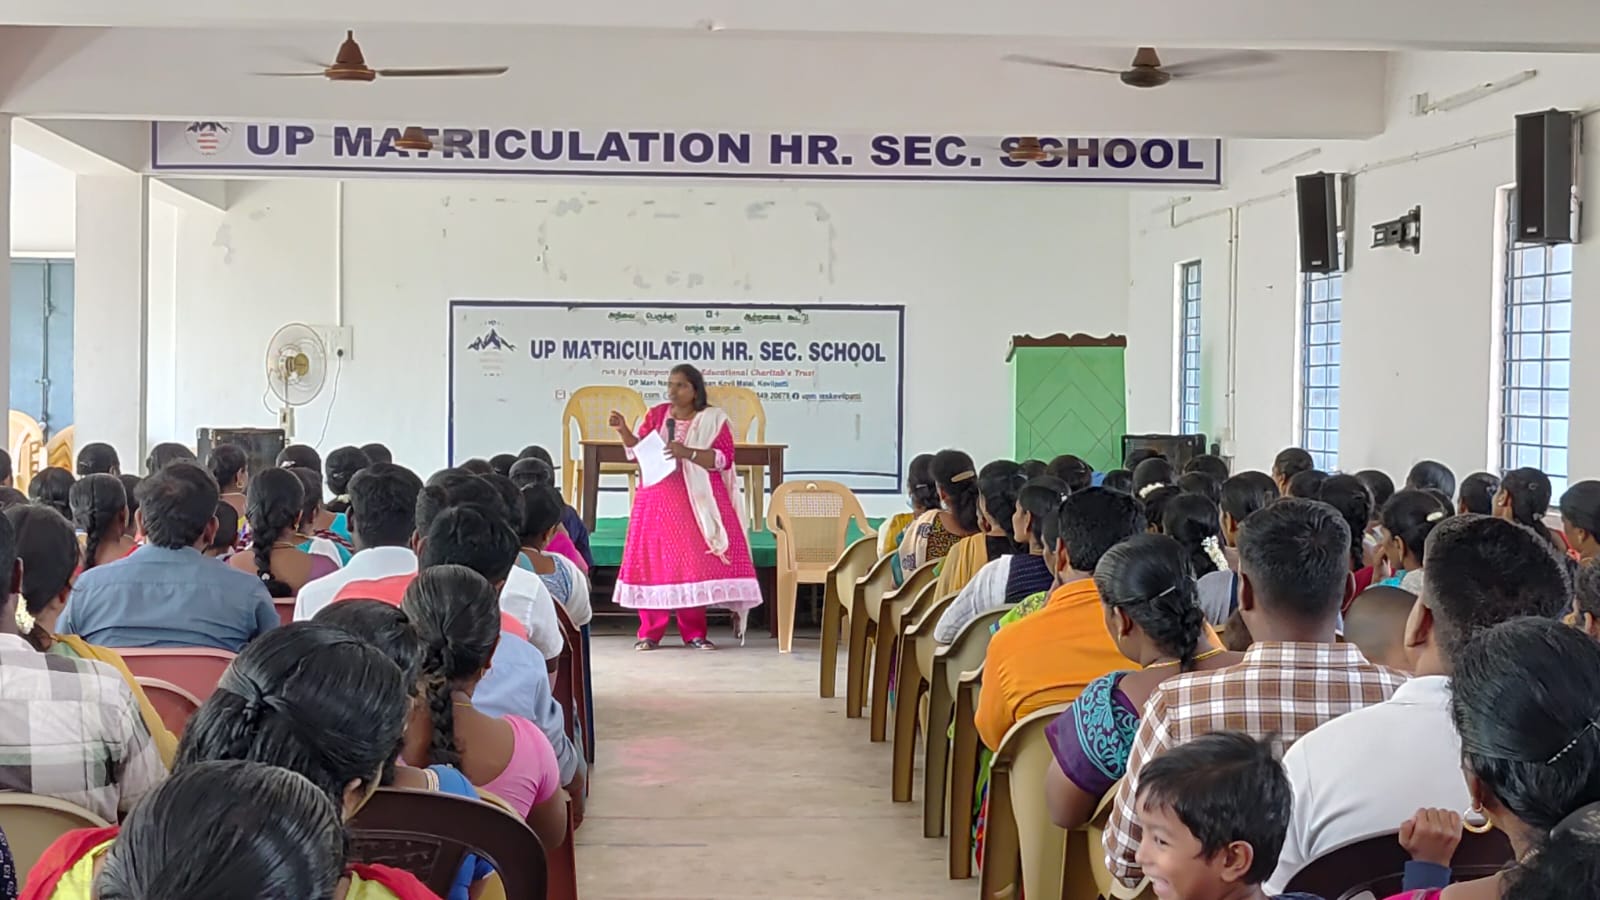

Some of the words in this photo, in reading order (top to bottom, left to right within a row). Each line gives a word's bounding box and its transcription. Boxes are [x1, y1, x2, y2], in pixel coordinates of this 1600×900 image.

[246, 125, 314, 155] UP
[770, 135, 852, 165] HR.
[871, 135, 982, 168] SEC.
[1000, 137, 1204, 170] SCHOOL
[530, 340, 555, 358] UP
[562, 340, 715, 361] MATRICULATION
[722, 342, 753, 361] HR.
[759, 342, 802, 362] SEC.
[808, 343, 886, 362] SCHOOL
